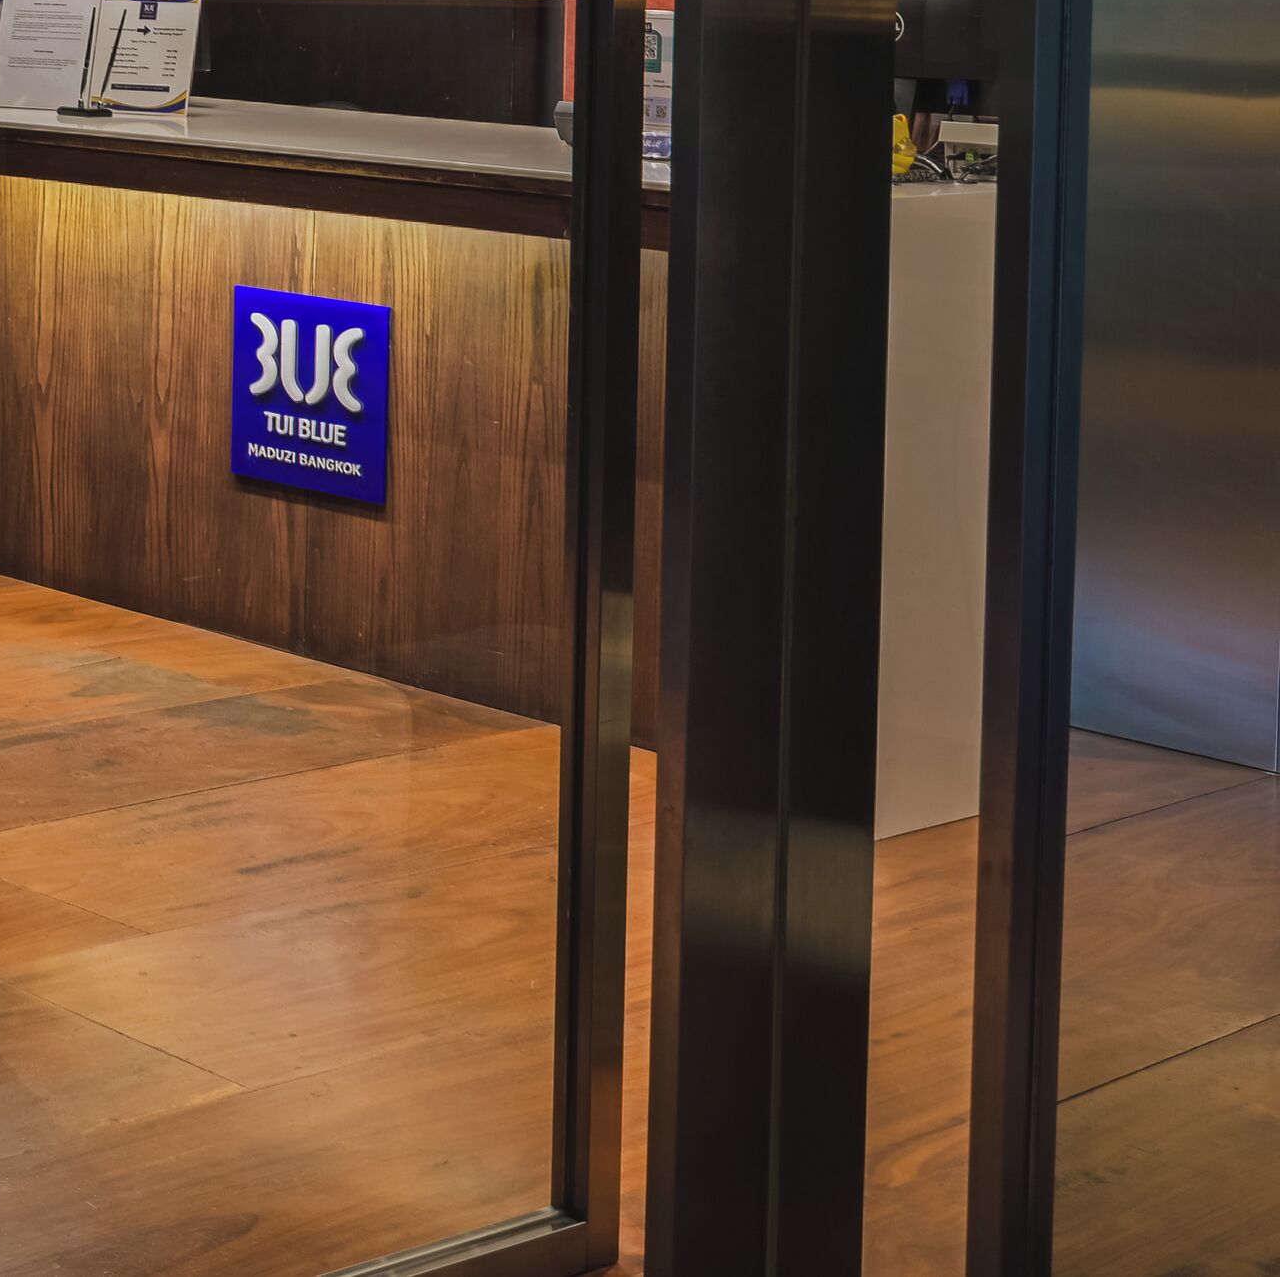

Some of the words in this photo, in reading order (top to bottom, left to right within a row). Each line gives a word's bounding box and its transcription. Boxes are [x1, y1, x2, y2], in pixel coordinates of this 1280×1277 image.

[263, 410, 294, 437] TUI
[298, 417, 347, 446] BLUE
[248, 442, 296, 464] MADUZI
[299, 454, 362, 477] BANGKOK
